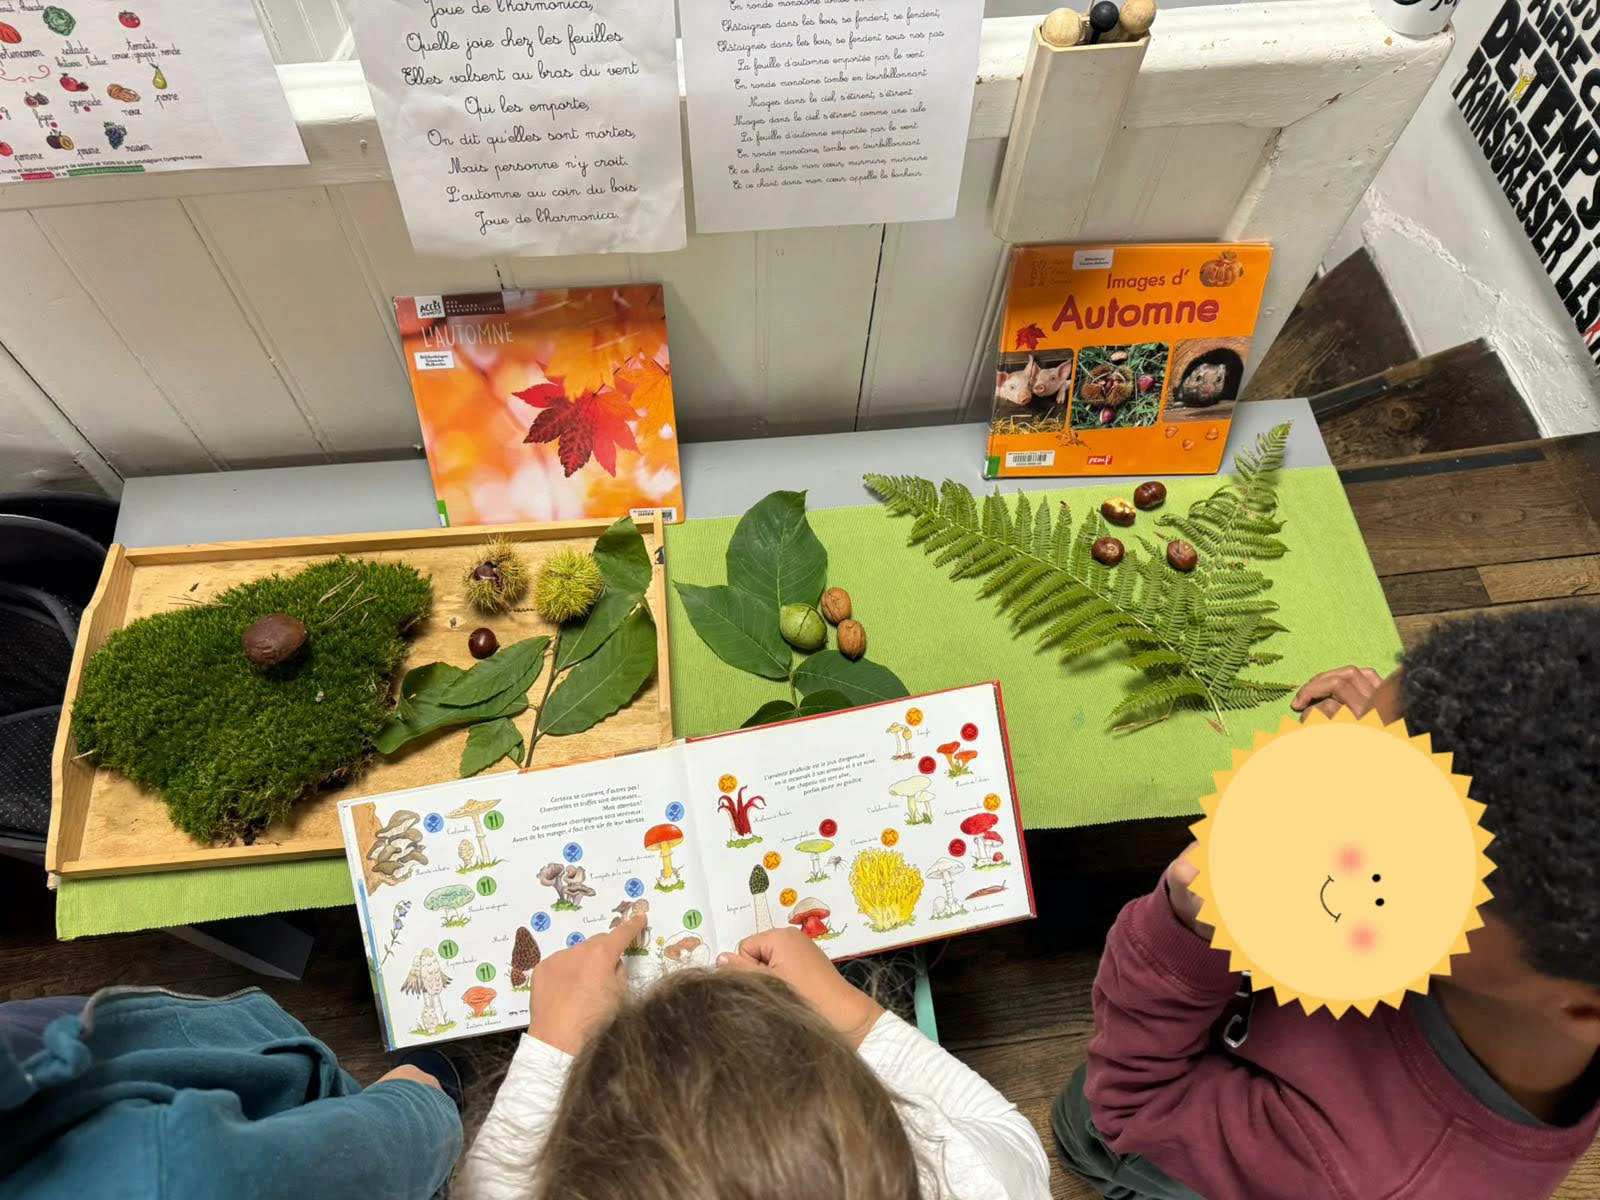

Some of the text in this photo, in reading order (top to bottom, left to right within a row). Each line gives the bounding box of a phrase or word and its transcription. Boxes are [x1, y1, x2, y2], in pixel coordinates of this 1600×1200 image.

[471, 0, 491, 15] de
[62, 40, 90, 54] salade
[126, 36, 157, 51] tomate
[407, 23, 624, 60] Quelle joie chez les feuilles
[1480, 0, 1542, 93] DE
[402, 61, 639, 85] Elles valsent au bras du vent
[465, 95, 589, 122] Qui les emporte,
[428, 126, 636, 153] On dit qu'elles sont mortes,
[448, 155, 628, 180] Mais personne n'y croit.
[447, 177, 638, 202] L'automne au coin du bois
[1451, 46, 1600, 335] TRANSGRESSER LES
[475, 208, 619, 235] Joue de l'harmonica.
[1107, 272, 1165, 292] Images
[420, 300, 441, 312] ACCÈS
[1052, 294, 1220, 331] Automne
[421, 322, 513, 348] L'AUTOMNE
